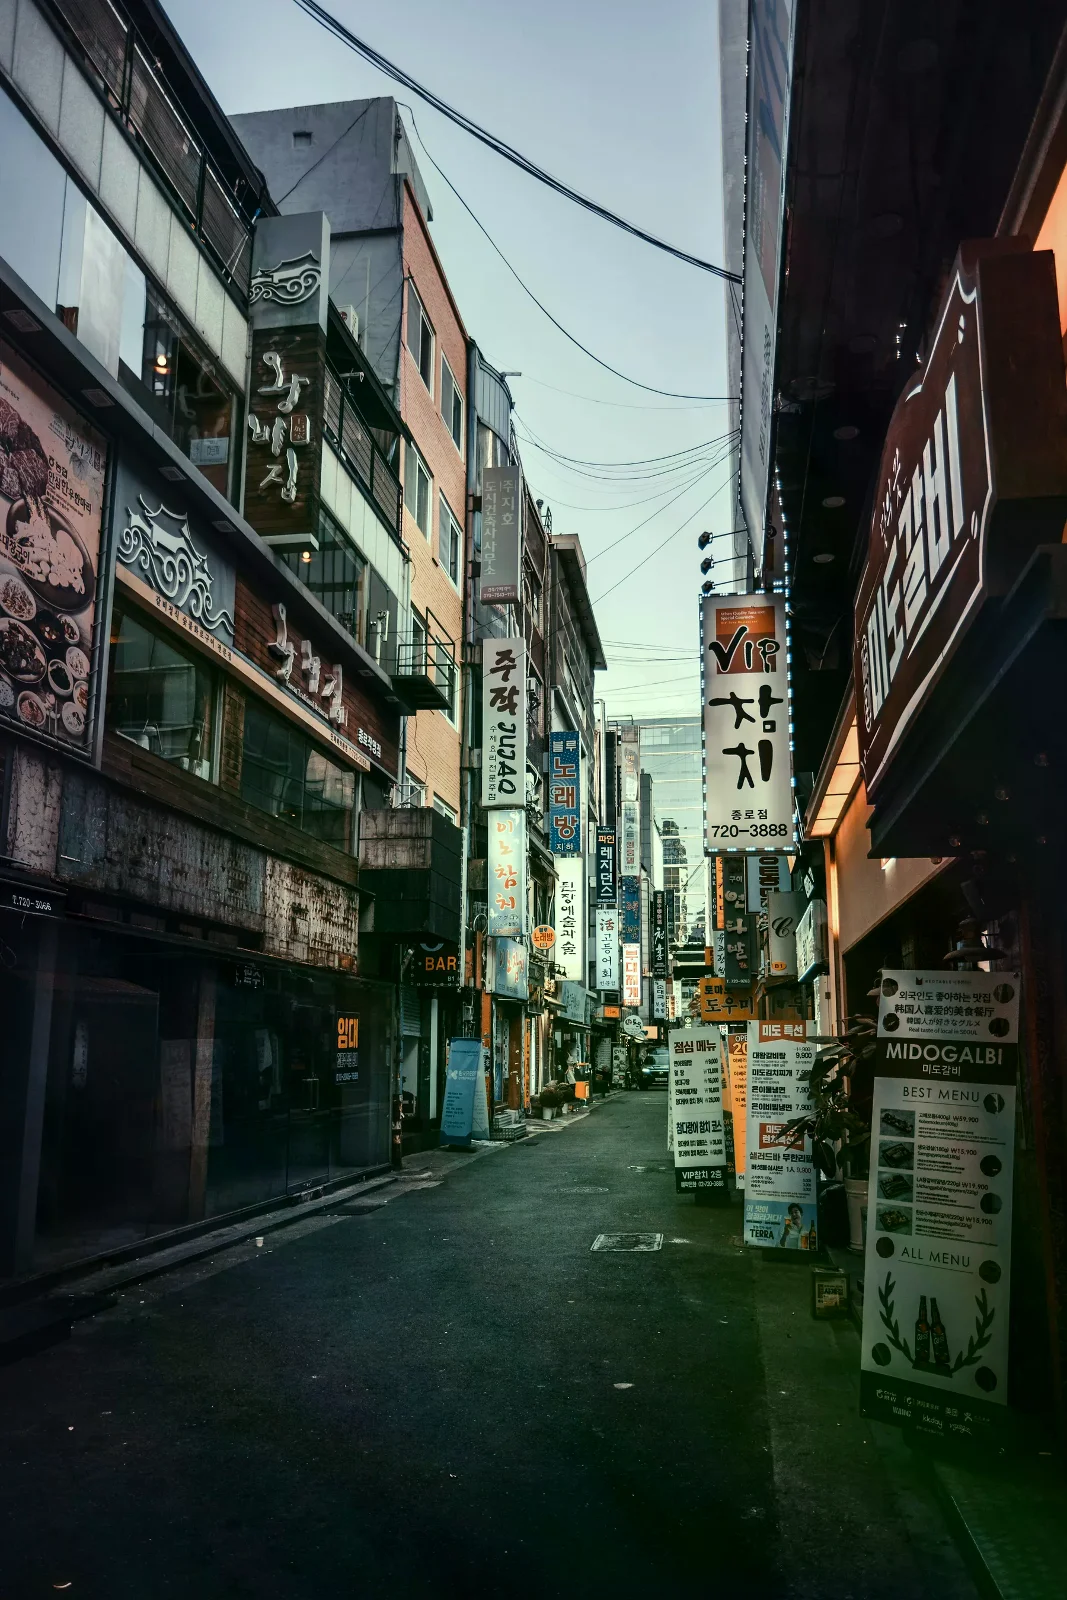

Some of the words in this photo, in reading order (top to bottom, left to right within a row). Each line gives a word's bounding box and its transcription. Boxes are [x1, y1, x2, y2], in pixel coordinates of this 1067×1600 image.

[866, 371, 965, 718] 미도갈비
[708, 626, 781, 674] VIP
[489, 649, 520, 716] 주작
[708, 684, 784, 790] 참치
[552, 740, 577, 753] 블루
[553, 756, 579, 840] 노래방
[731, 809, 768, 820] 종로점
[712, 823, 787, 838] 720-3888
[556, 842, 574, 851] 지하
[597, 835, 615, 845] 파인
[600, 846, 613, 897] 레지던스
[729, 875, 743, 883] 구이
[533, 932, 554, 942] 노래방
[425, 956, 457, 971] BAR
[704, 985, 735, 995] 토마
[899, 991, 934, 1001] 외국인도
[936, 992, 971, 1003] 좋아하는
[973, 993, 991, 1003] 맛집
[704, 996, 754, 1015] 도우미
[894, 1004, 995, 1018] 韩国人喜爱的美食餐厅
[336, 1017, 359, 1049] 임대
[762, 1025, 781, 1037] 미도
[783, 1024, 803, 1037] 특선
[673, 1041, 694, 1054] 점심
[696, 1040, 717, 1052] 메뉴
[885, 1042, 1003, 1065] MIDOGALBI
[752, 1052, 786, 1060] 대왕갈비탕
[752, 1068, 793, 1077] 미도김치찌개
[922, 1064, 961, 1076] 미도갈비
[903, 1086, 933, 1098] BEST
[938, 1090, 980, 1102] MENU
[699, 1120, 711, 1133] 참치
[711, 1120, 723, 1132] 코스
[750, 1152, 781, 1162] 샐러드바
[681, 1170, 708, 1180] VIP참치
[710, 1169, 722, 1179] 2층
[746, 1204, 753, 1212] 이
[755, 1205, 769, 1213] 맛이
[749, 1228, 775, 1240] TERRA
[901, 1246, 922, 1260] ALL
[929, 1251, 971, 1268] MENU
